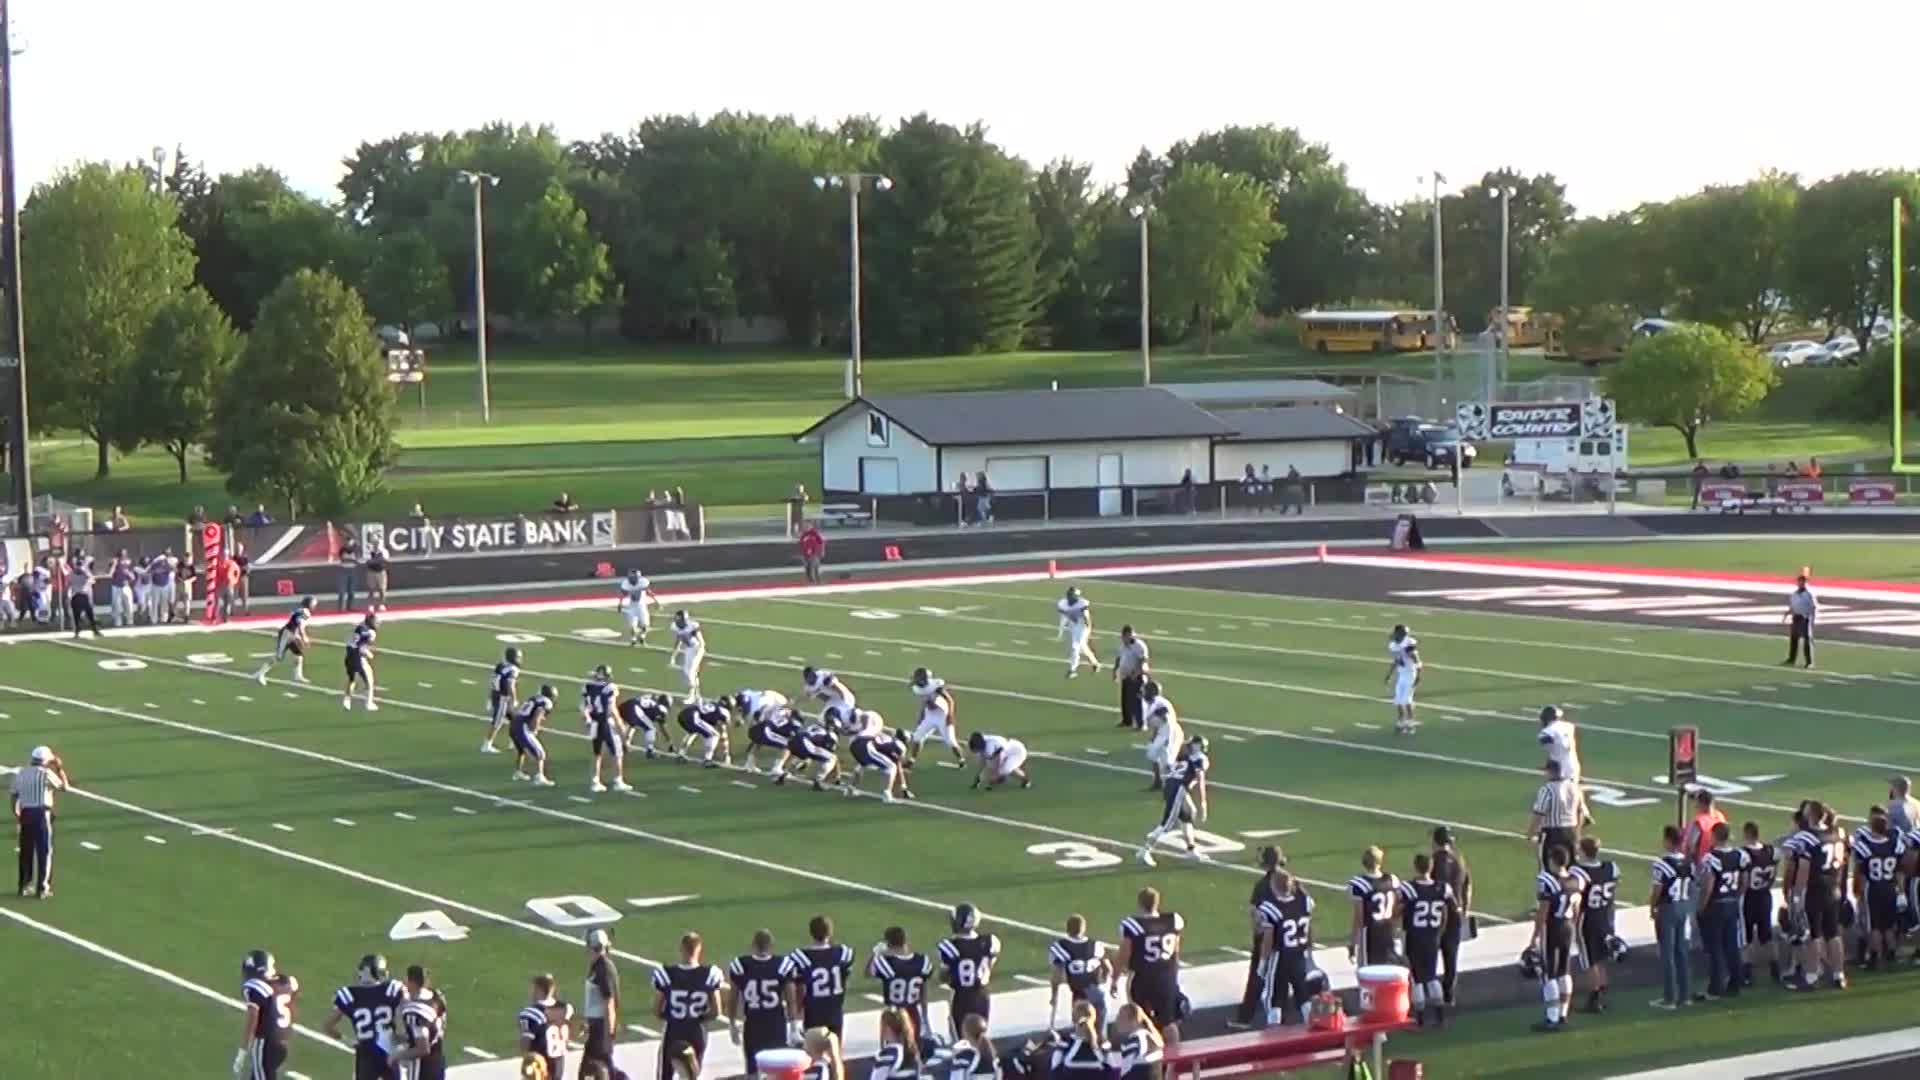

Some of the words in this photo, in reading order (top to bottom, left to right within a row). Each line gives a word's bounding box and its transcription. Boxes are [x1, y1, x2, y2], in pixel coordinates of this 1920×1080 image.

[1491, 422, 1579, 435] COUNTRY
[1497, 407, 1572, 421] RAIDER
[389, 526, 445, 551] CITY
[452, 521, 516, 549] STATE
[524, 519, 588, 545] BANK
[1868, 856, 1897, 881] 89
[1371, 891, 1394, 921] 31
[1588, 881, 1617, 909] 65
[1413, 901, 1445, 928] 25
[1283, 916, 1310, 948] 23
[1144, 932, 1177, 963] 59
[812, 965, 844, 997] 21
[958, 956, 991, 987] 84
[670, 989, 709, 1019] 52
[744, 979, 779, 1009] 45
[889, 976, 924, 1004] 86
[276, 993, 291, 1028] 5
[354, 1005, 393, 1040] 22
